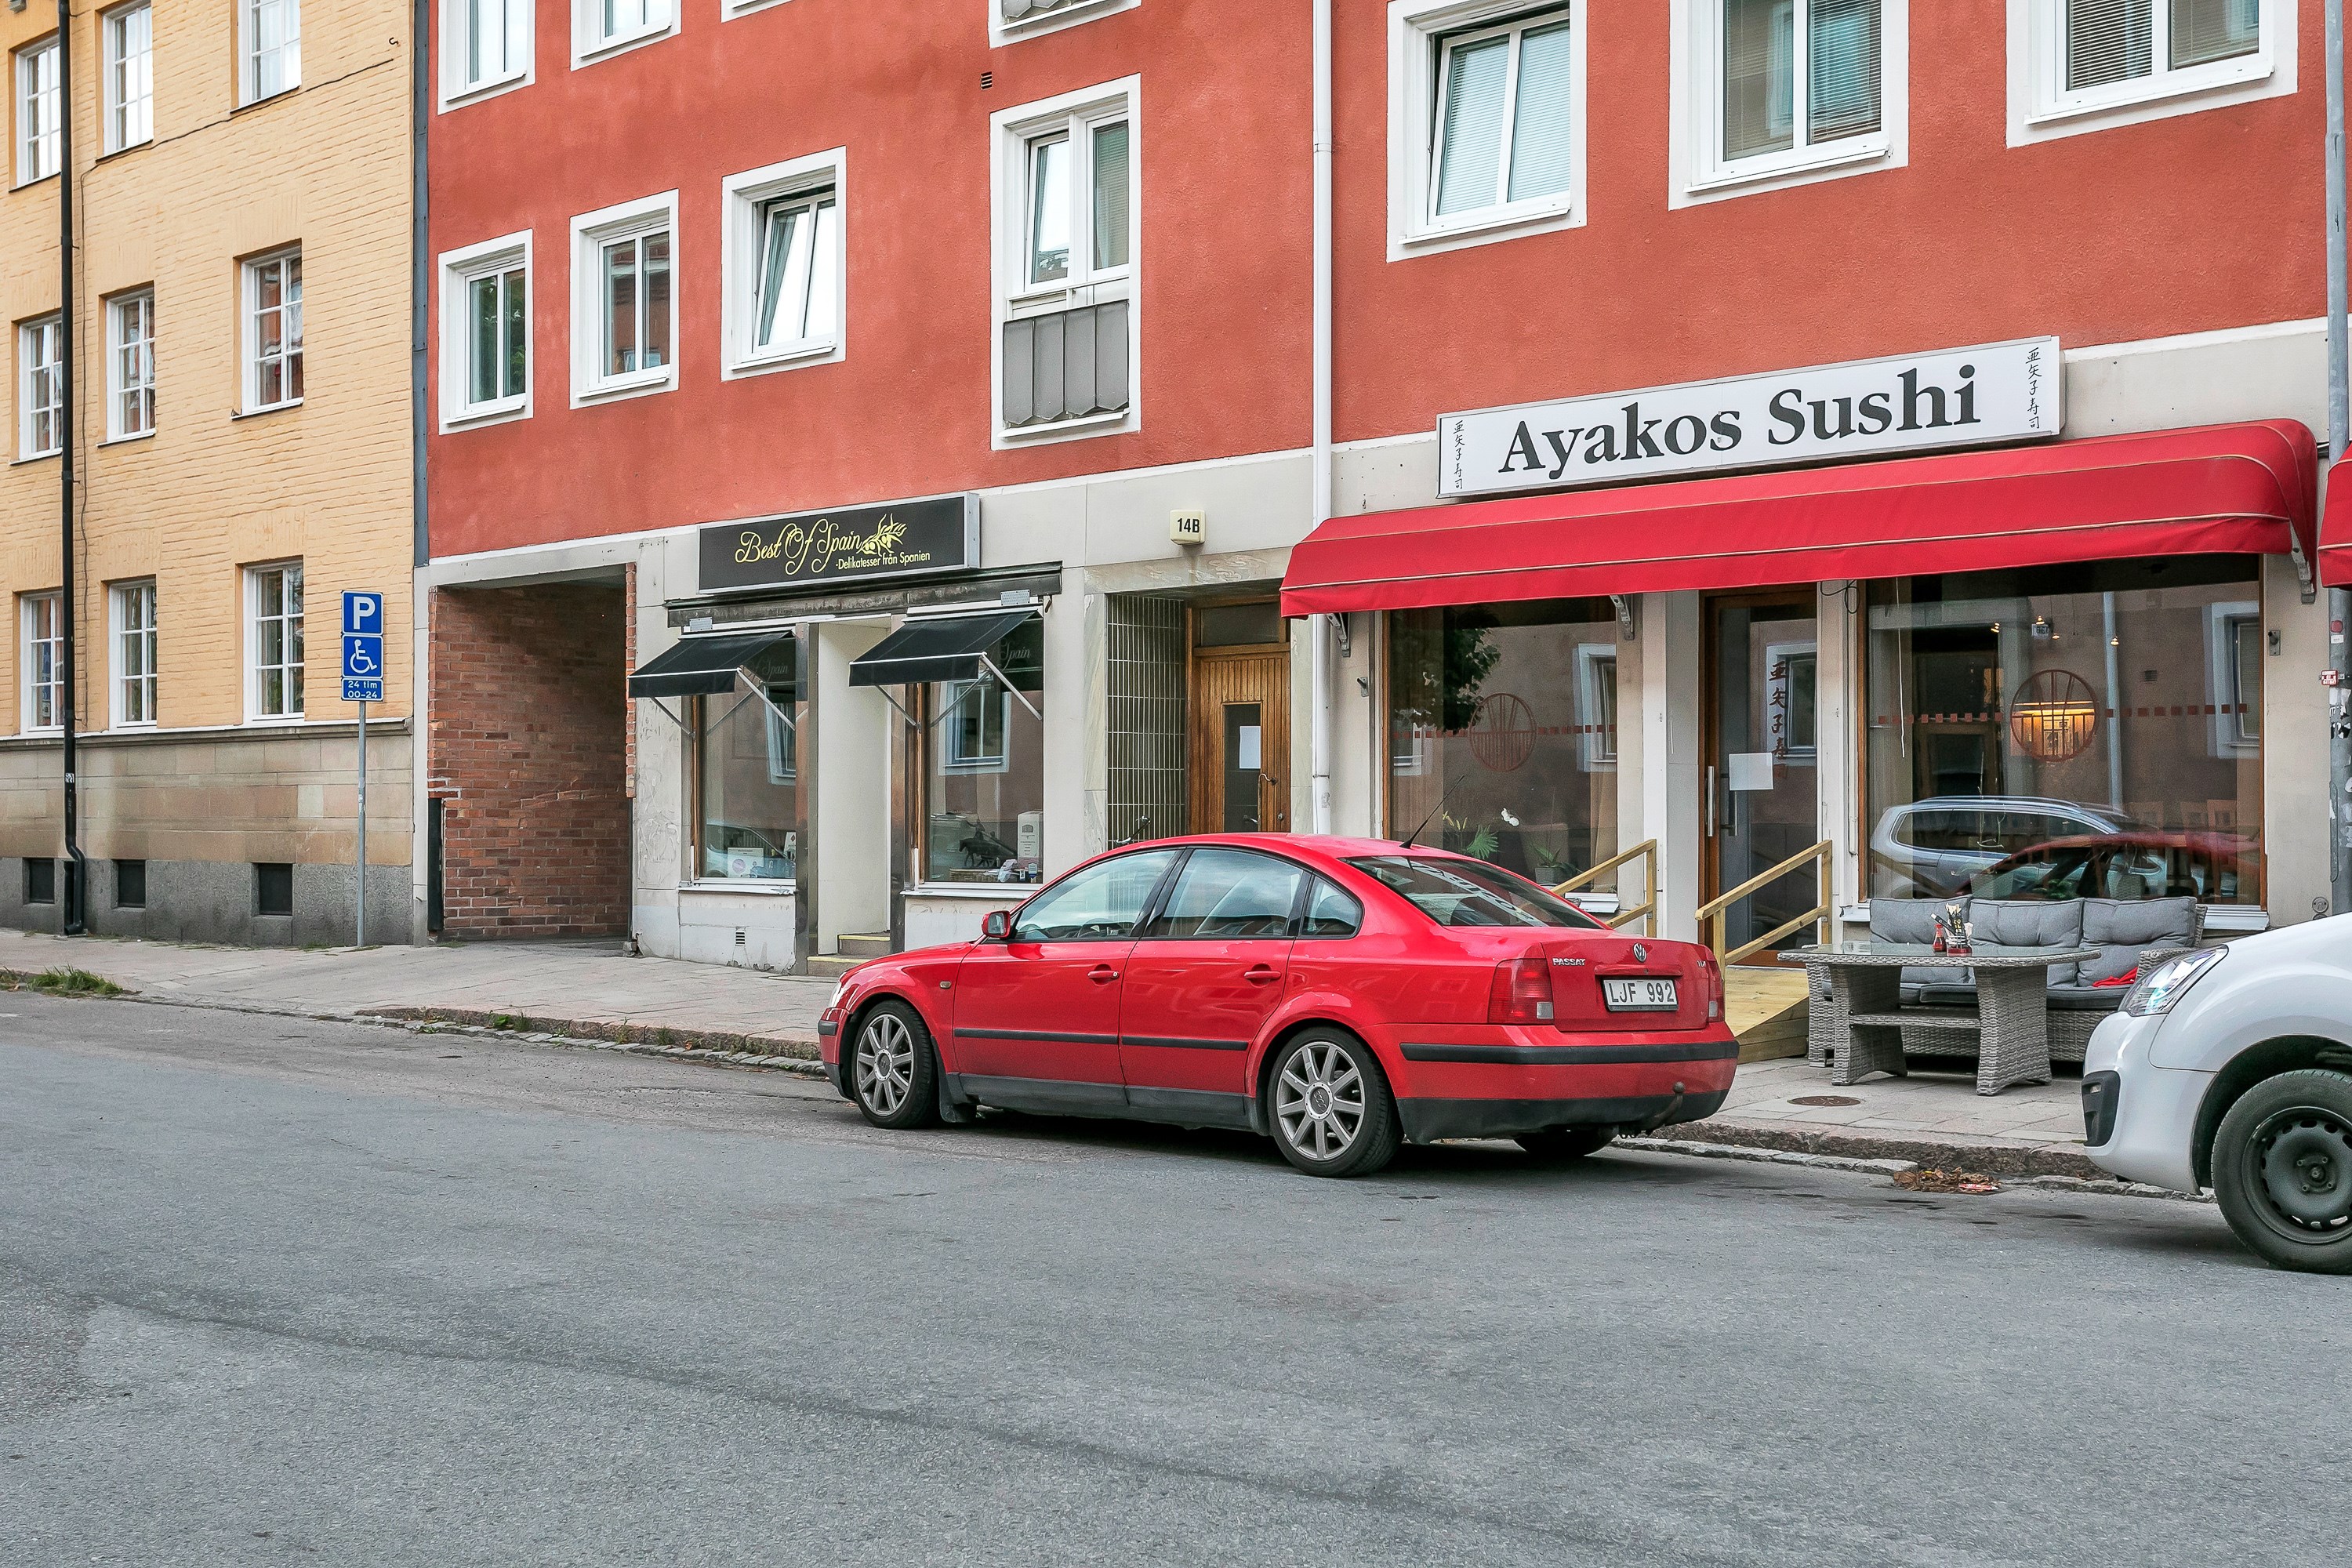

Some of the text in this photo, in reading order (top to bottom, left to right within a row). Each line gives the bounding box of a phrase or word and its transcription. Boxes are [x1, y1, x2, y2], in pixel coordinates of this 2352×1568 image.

[1497, 364, 1981, 480] Ayakos Sushi
[1177, 517, 1200, 533] 14B
[735, 518, 862, 575] Best Of Spain
[835, 550, 931, 571] -Delikatesser från Spanien
[353, 596, 376, 630] P
[363, 681, 378, 689] tim
[1552, 957, 1586, 966] PASSAT
[1609, 982, 1675, 1003] LJF 992
